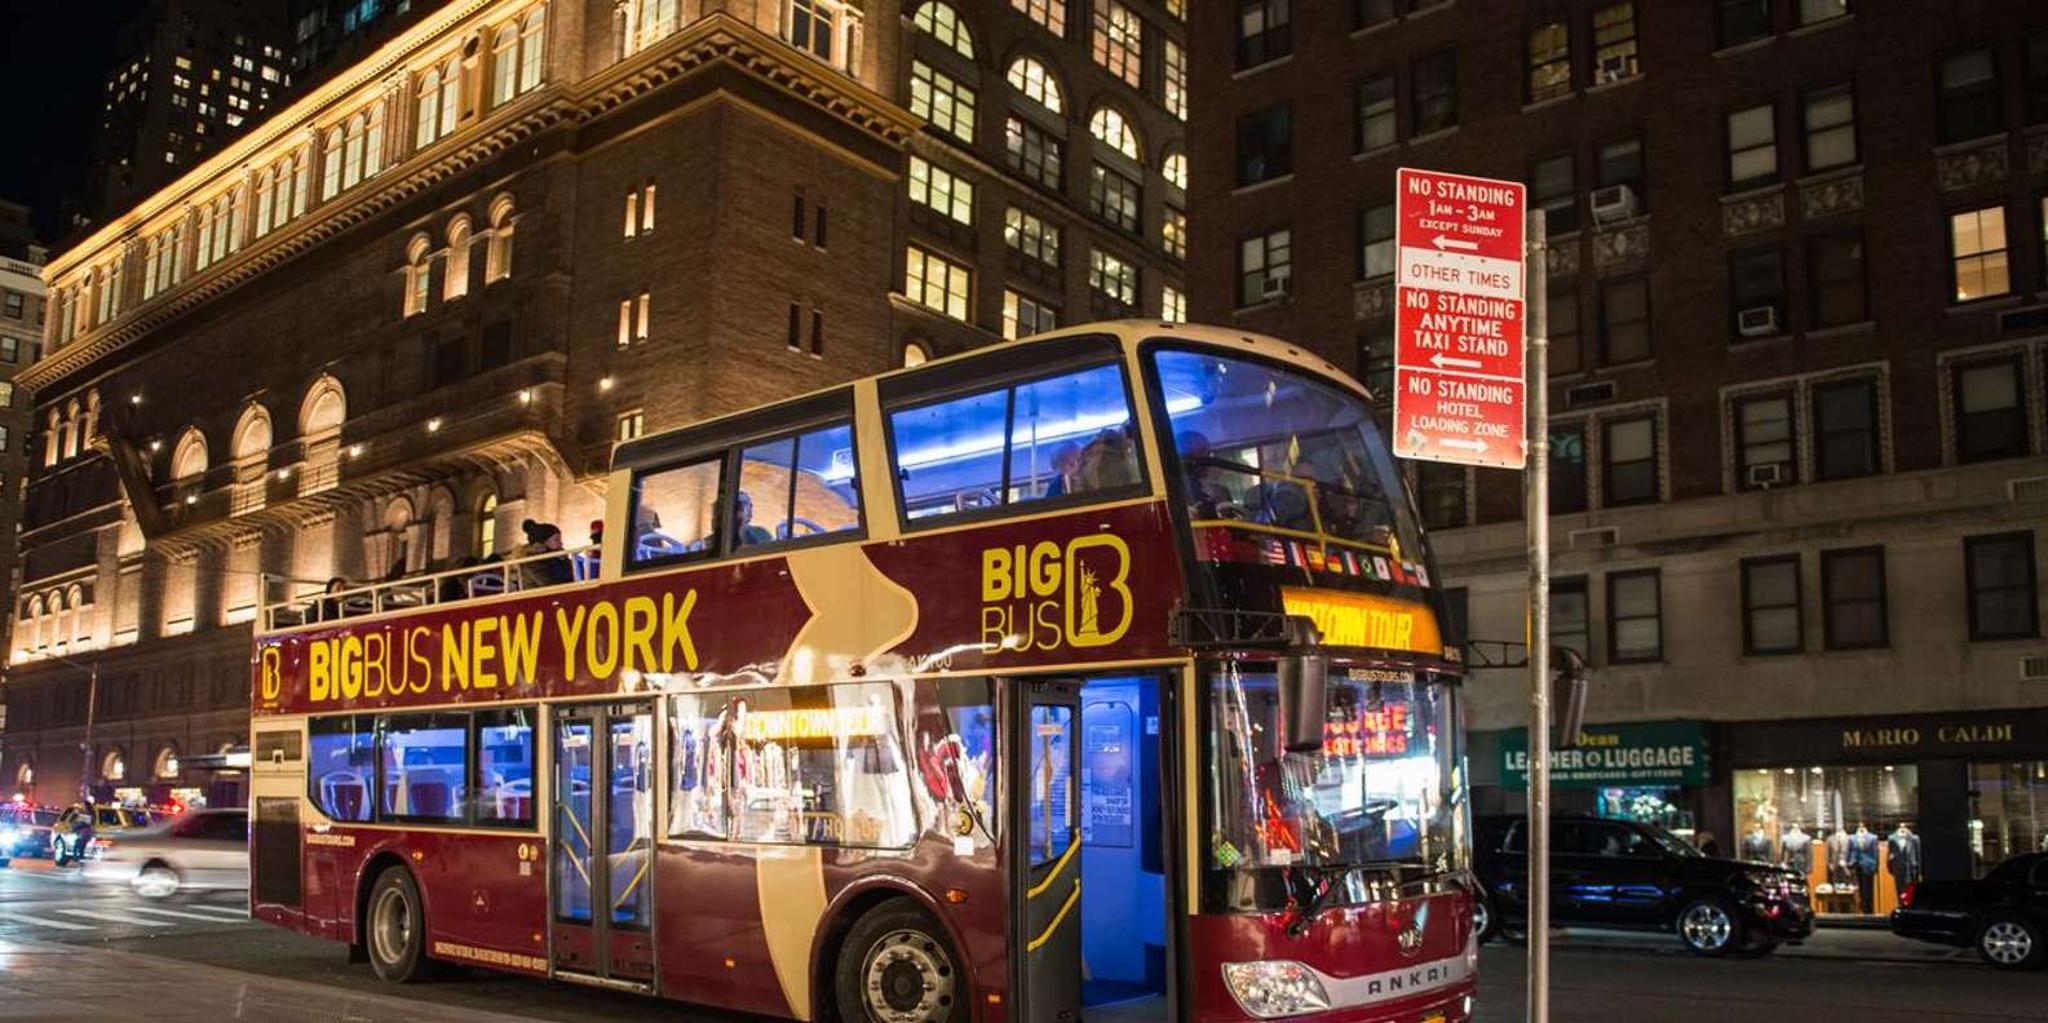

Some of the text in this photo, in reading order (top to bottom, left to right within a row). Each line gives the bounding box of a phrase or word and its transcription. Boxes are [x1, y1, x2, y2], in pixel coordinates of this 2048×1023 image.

[1408, 177, 1515, 207] NO STANDING
[1428, 200, 1453, 216] 1AM
[1467, 204, 1495, 221] 3AM
[1419, 218, 1503, 238] EXCEPT SUNDAY
[1411, 263, 1511, 289] OTHER TIMES
[1406, 290, 1515, 320] NO STANDING
[1420, 312, 1502, 338] ANYTIME
[1414, 330, 1508, 357] TAXI STAND
[1409, 377, 1513, 405] NO STANDING
[1437, 400, 1483, 419] HOTEL
[1411, 415, 1509, 438] LOADING ZONE
[983, 541, 1062, 602] BIG
[442, 611, 544, 692] NEW
[555, 588, 699, 682] YORK
[982, 601, 1062, 654] BUS
[1370, 610, 1413, 650] TOUR
[1843, 724, 2014, 747] MARIO CALDI
[1505, 751, 1583, 770] LEHER
[1605, 747, 1694, 767] LUGGAGE
[1368, 966, 1449, 995] ANKAI
